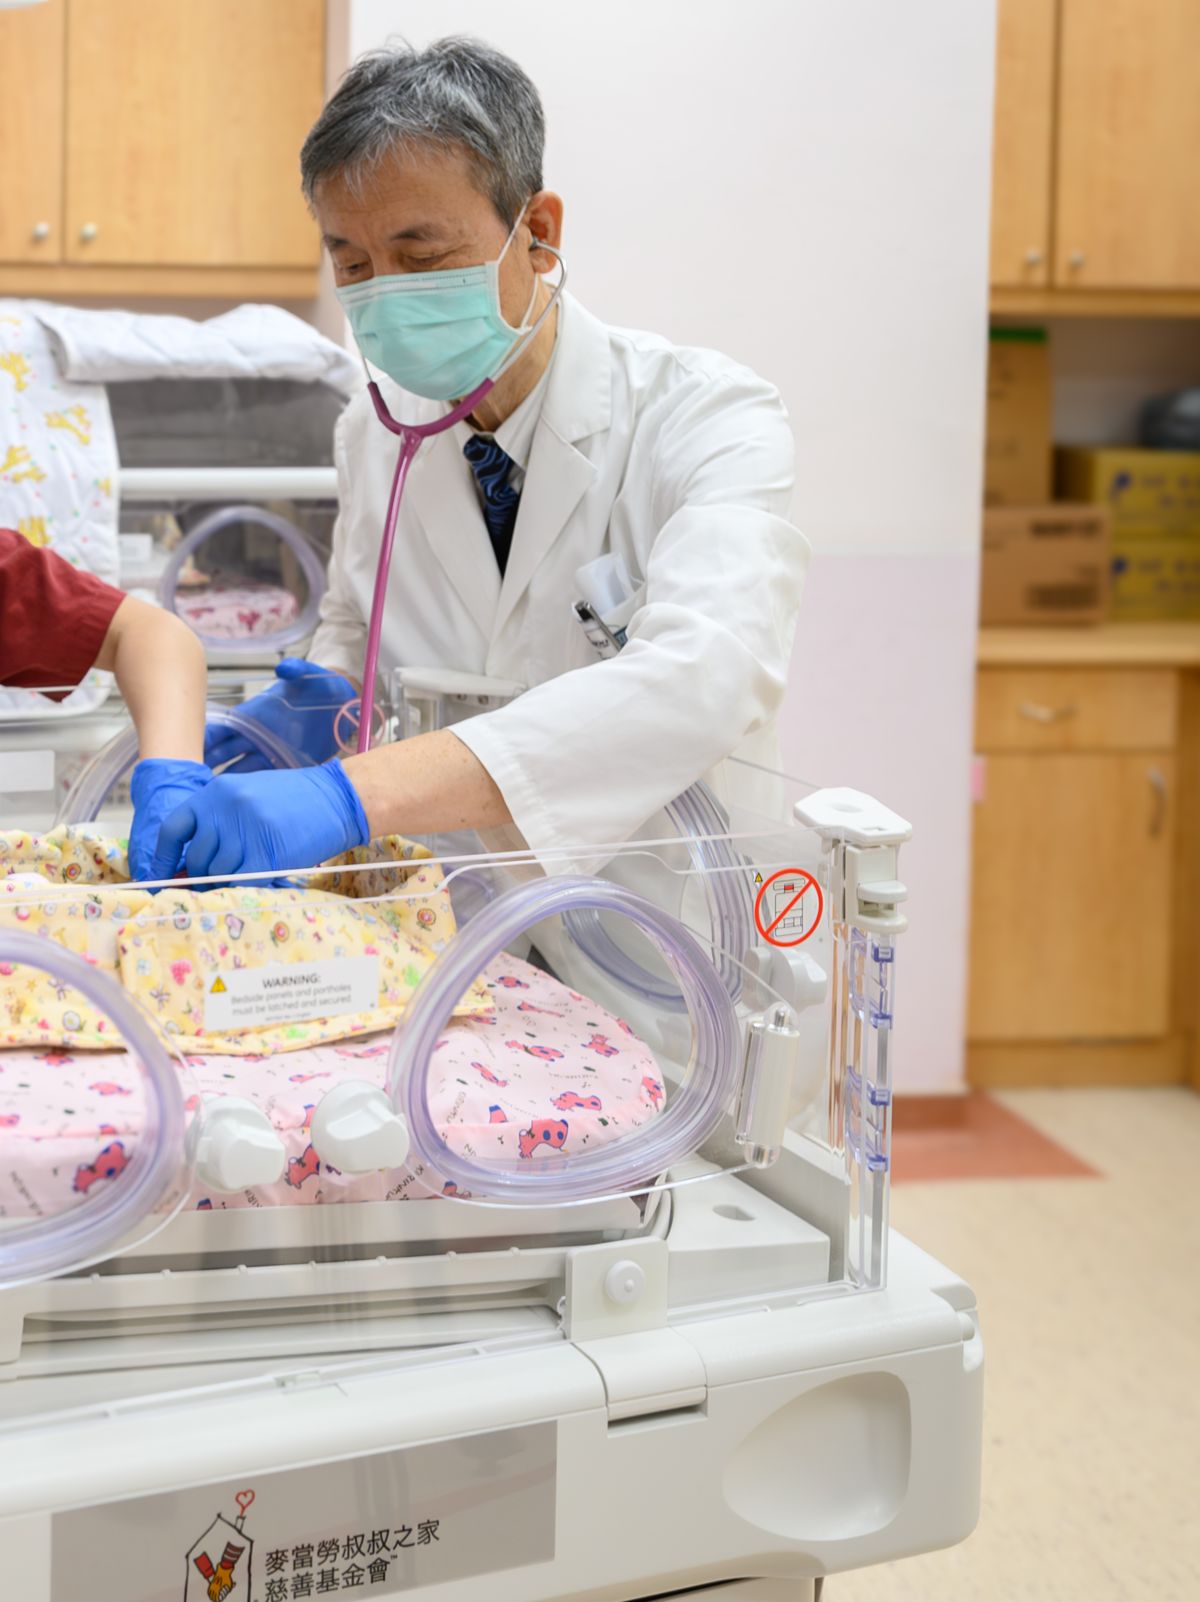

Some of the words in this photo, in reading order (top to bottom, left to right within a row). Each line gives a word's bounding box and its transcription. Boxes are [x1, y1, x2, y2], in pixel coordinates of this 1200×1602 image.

[262, 973, 322, 989] WARNING:
[231, 993, 264, 1005] Bedside
[265, 990, 293, 1003] panels
[295, 987, 311, 998] and
[313, 984, 352, 997] portholes
[232, 1006, 253, 1016] must
[255, 1004, 266, 1014] be
[267, 1000, 299, 1012] latched
[301, 997, 317, 1008] and
[264, 1519, 441, 1576] 麥當勞叔叔之家
